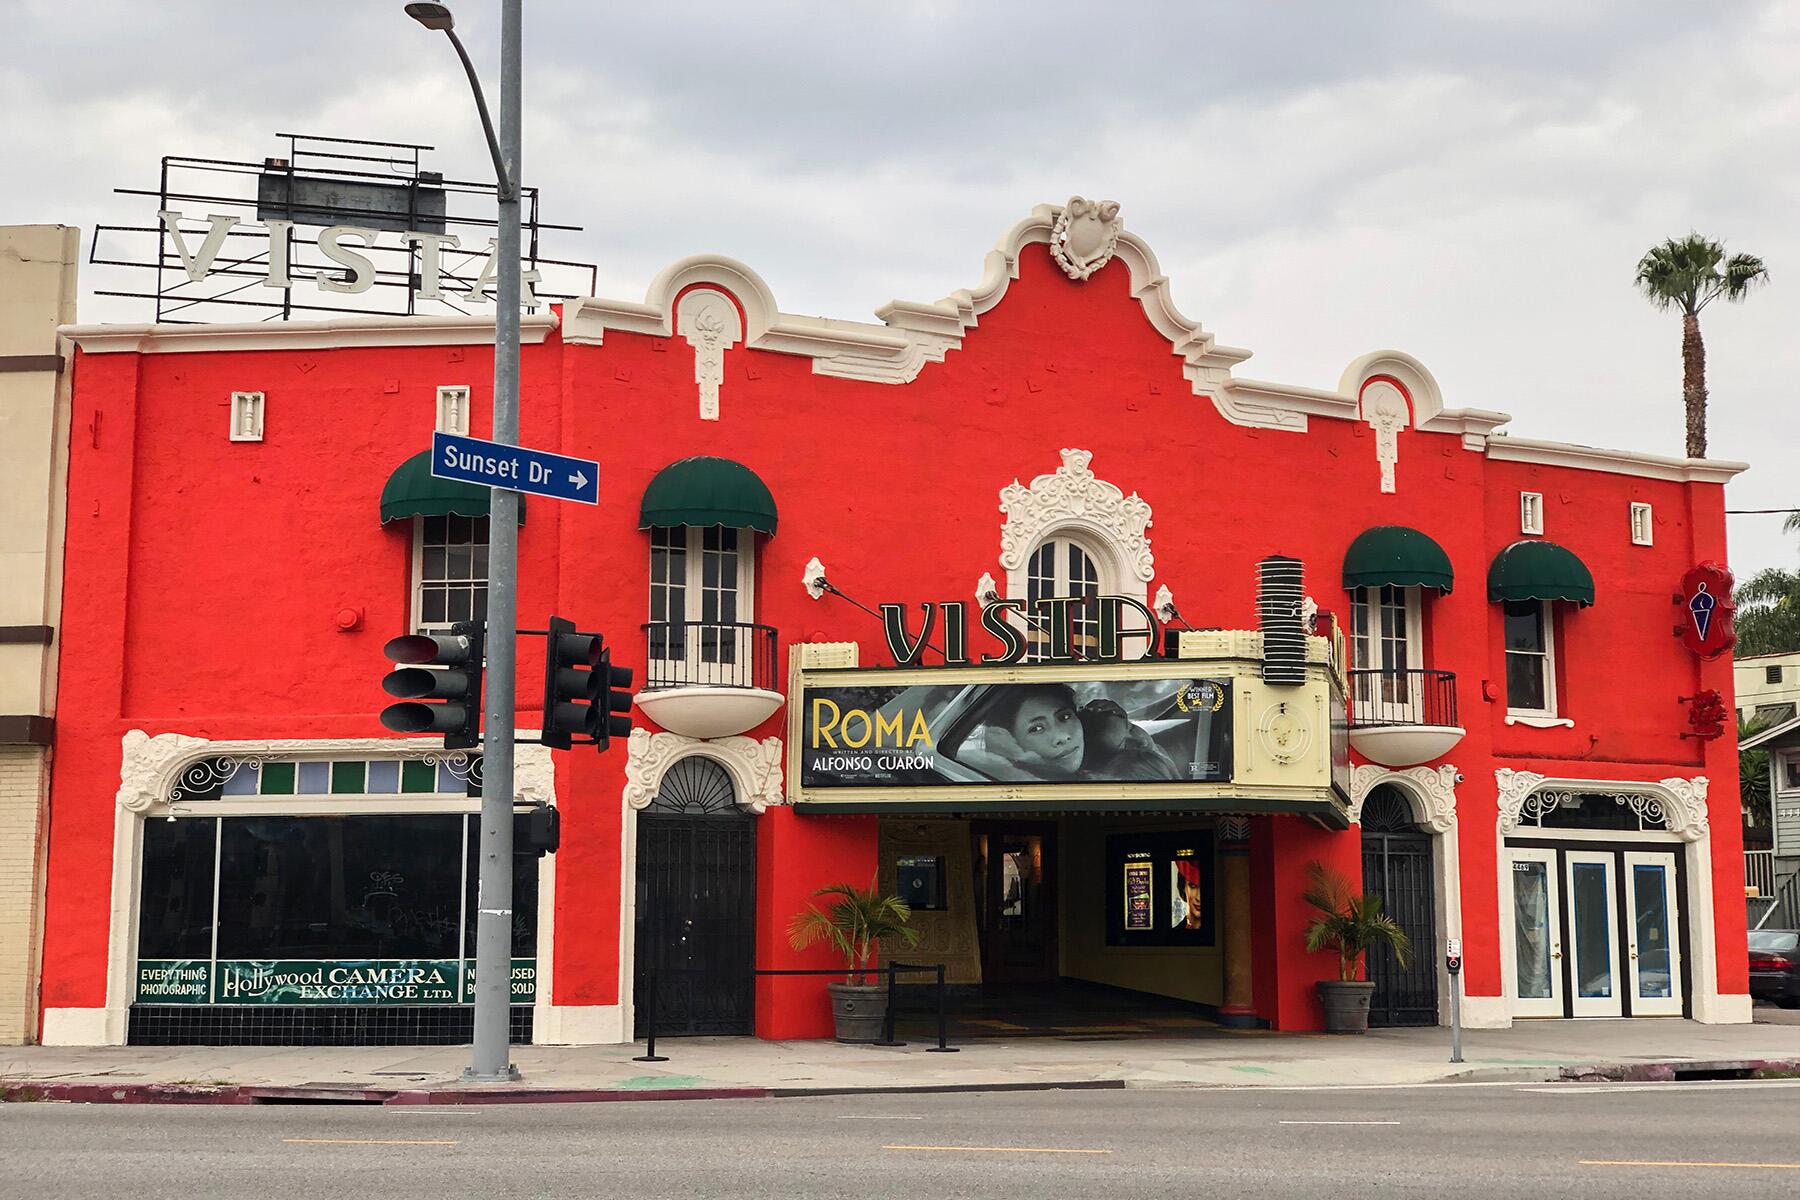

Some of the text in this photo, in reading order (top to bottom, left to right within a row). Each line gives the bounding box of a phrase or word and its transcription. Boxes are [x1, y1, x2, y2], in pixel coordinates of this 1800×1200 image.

[444, 445, 553, 485] Sunset Dr
[880, 596, 1158, 664] VISTA
[812, 698, 934, 749] ROMA
[812, 751, 934, 771] ALFONSO CUARÓN
[141, 969, 207, 981] EVERYTHING
[222, 967, 322, 998] Hollywood
[328, 968, 445, 984] CAMERA
[140, 983, 207, 995] PHOTOGRAPHIC
[299, 984, 418, 999] EXCHANGE
[423, 989, 454, 998] LTD.
[511, 982, 535, 995] SOLD
